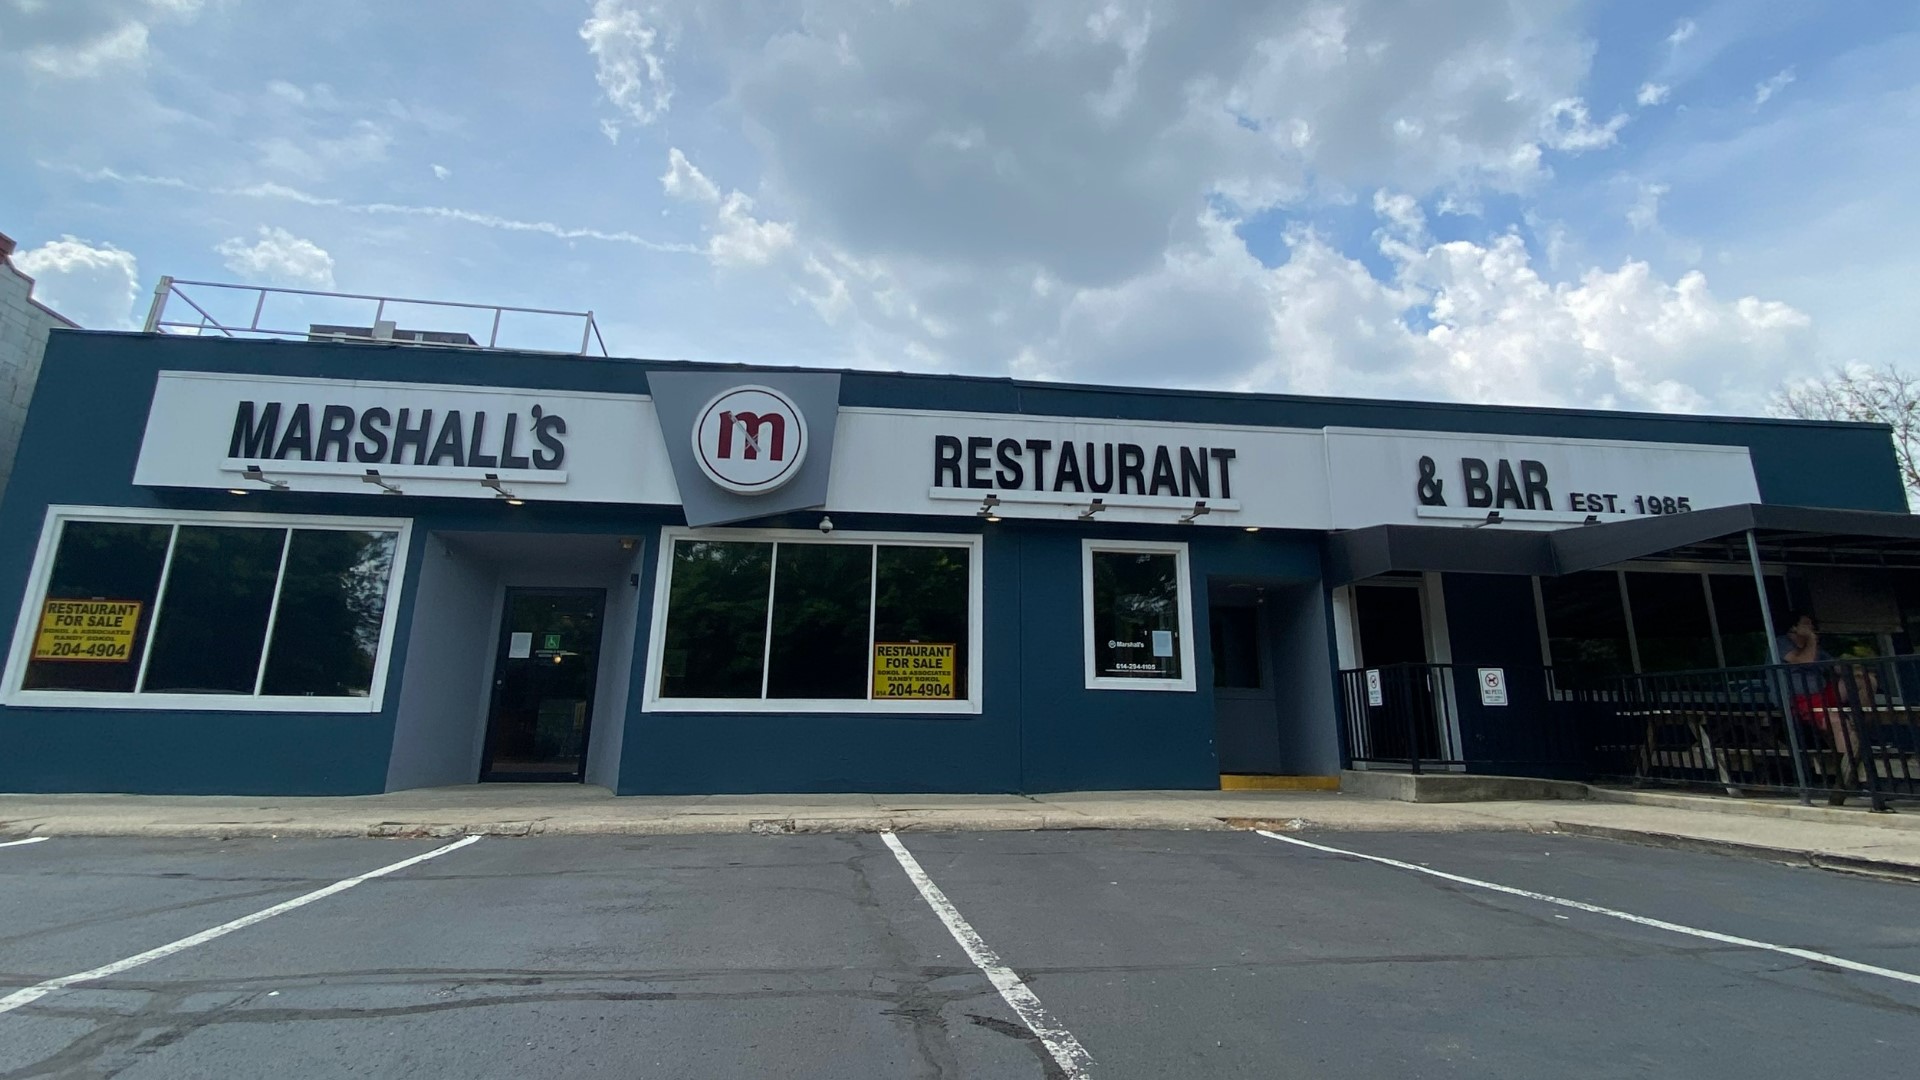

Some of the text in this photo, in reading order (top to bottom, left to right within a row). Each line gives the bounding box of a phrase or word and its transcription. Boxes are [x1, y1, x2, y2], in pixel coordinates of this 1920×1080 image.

[227, 400, 567, 470] MARSHALL'S
[933, 434, 1237, 499] RESTAURANT
[1416, 455, 1692, 515] & BAR EST. 1985
[48, 602, 137, 616] RESTAURANT
[55, 615, 124, 628] FOR SALE
[51, 642, 126, 657] 204-4904
[877, 646, 952, 657] RESTAURANT
[886, 658, 943, 669] FOR SALE
[888, 683, 950, 697] 204-4904
